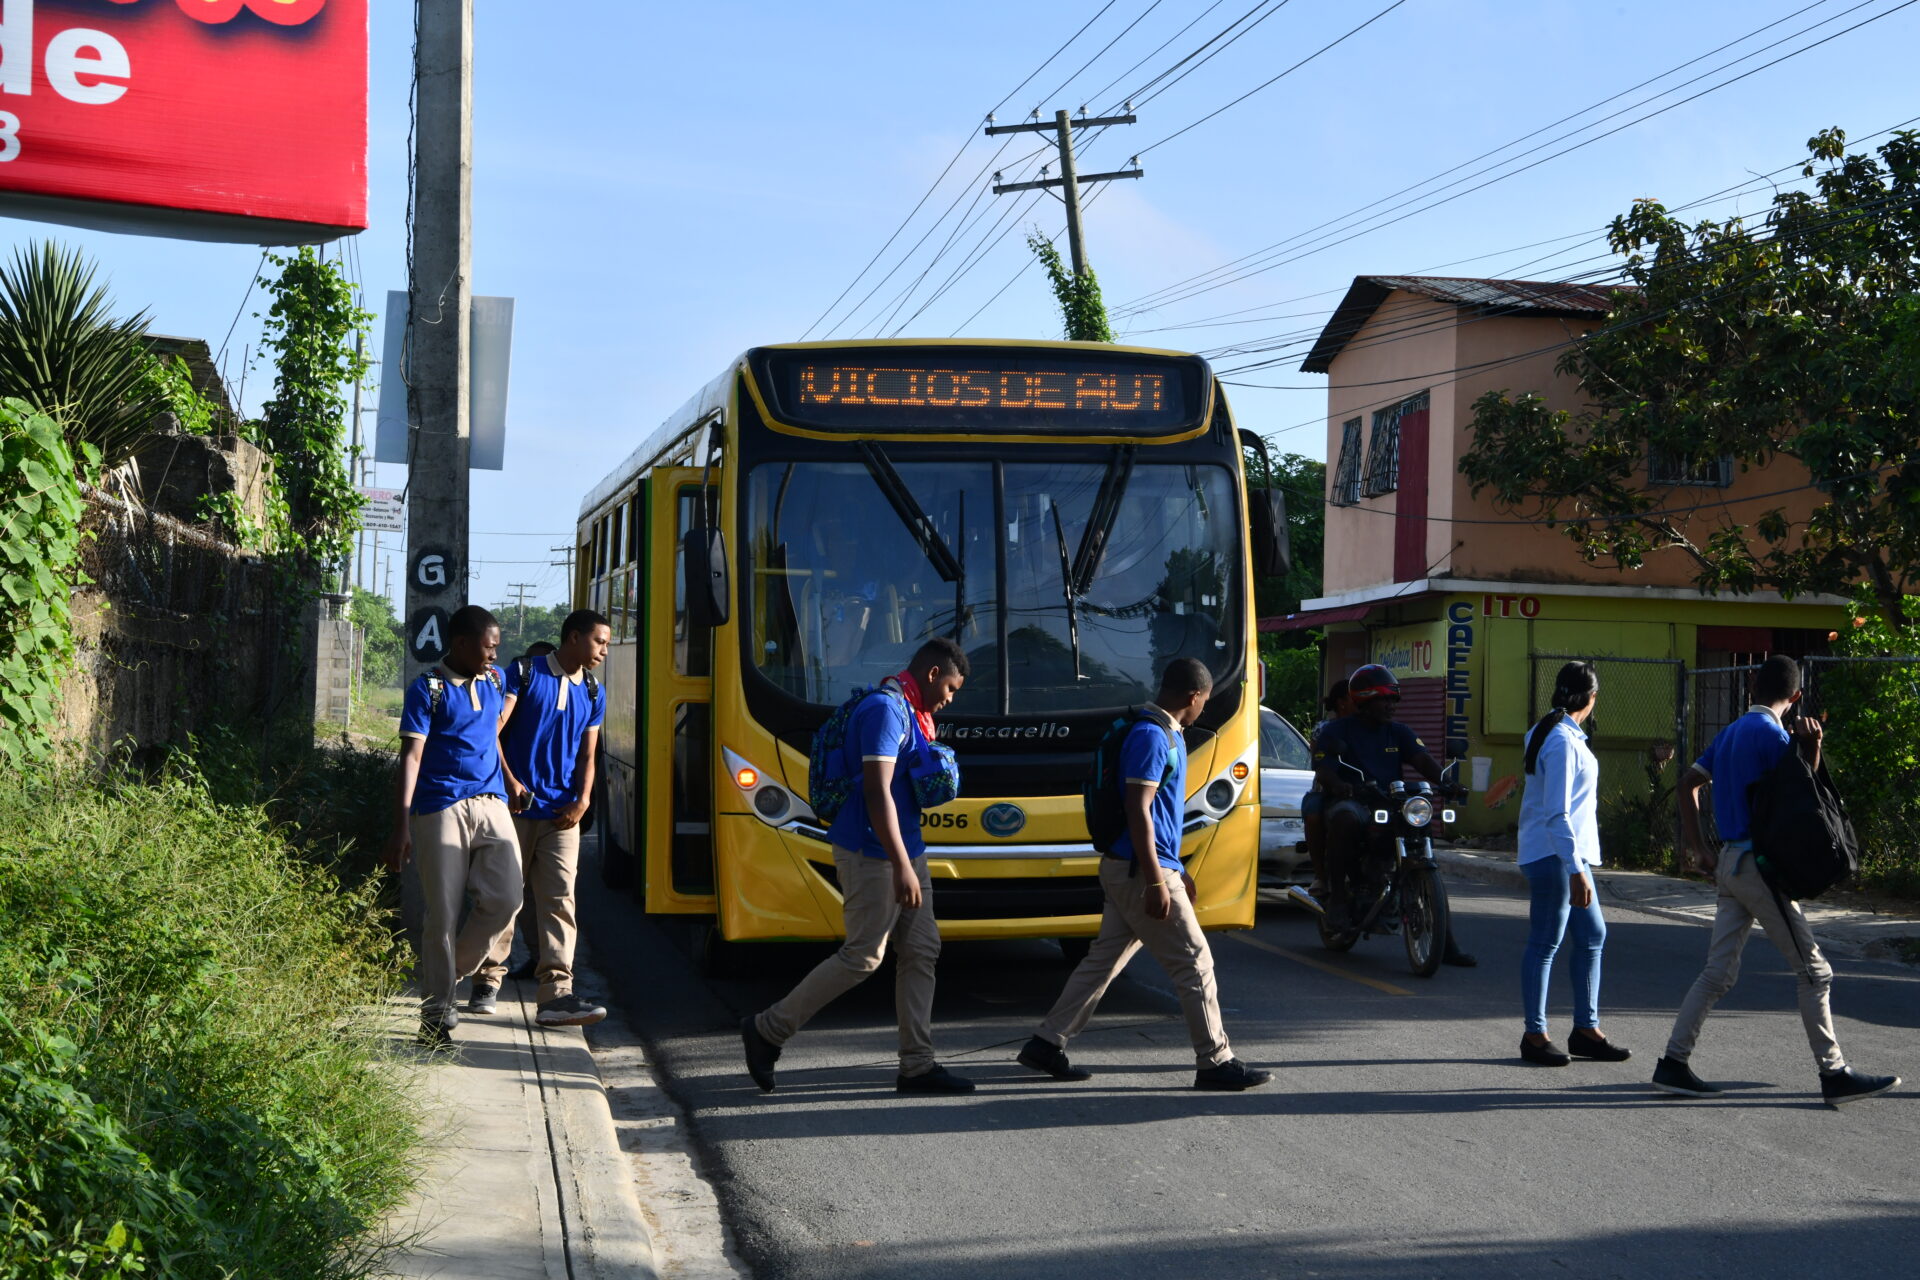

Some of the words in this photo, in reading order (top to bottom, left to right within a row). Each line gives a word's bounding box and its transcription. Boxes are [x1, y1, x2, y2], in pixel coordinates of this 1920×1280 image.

[801, 366, 990, 407] VICIOS
[1000, 371, 1067, 408] DE
[1483, 595, 1541, 618] ITO
[1411, 639, 1432, 672] ITO
[935, 722, 1070, 739] Mascarello
